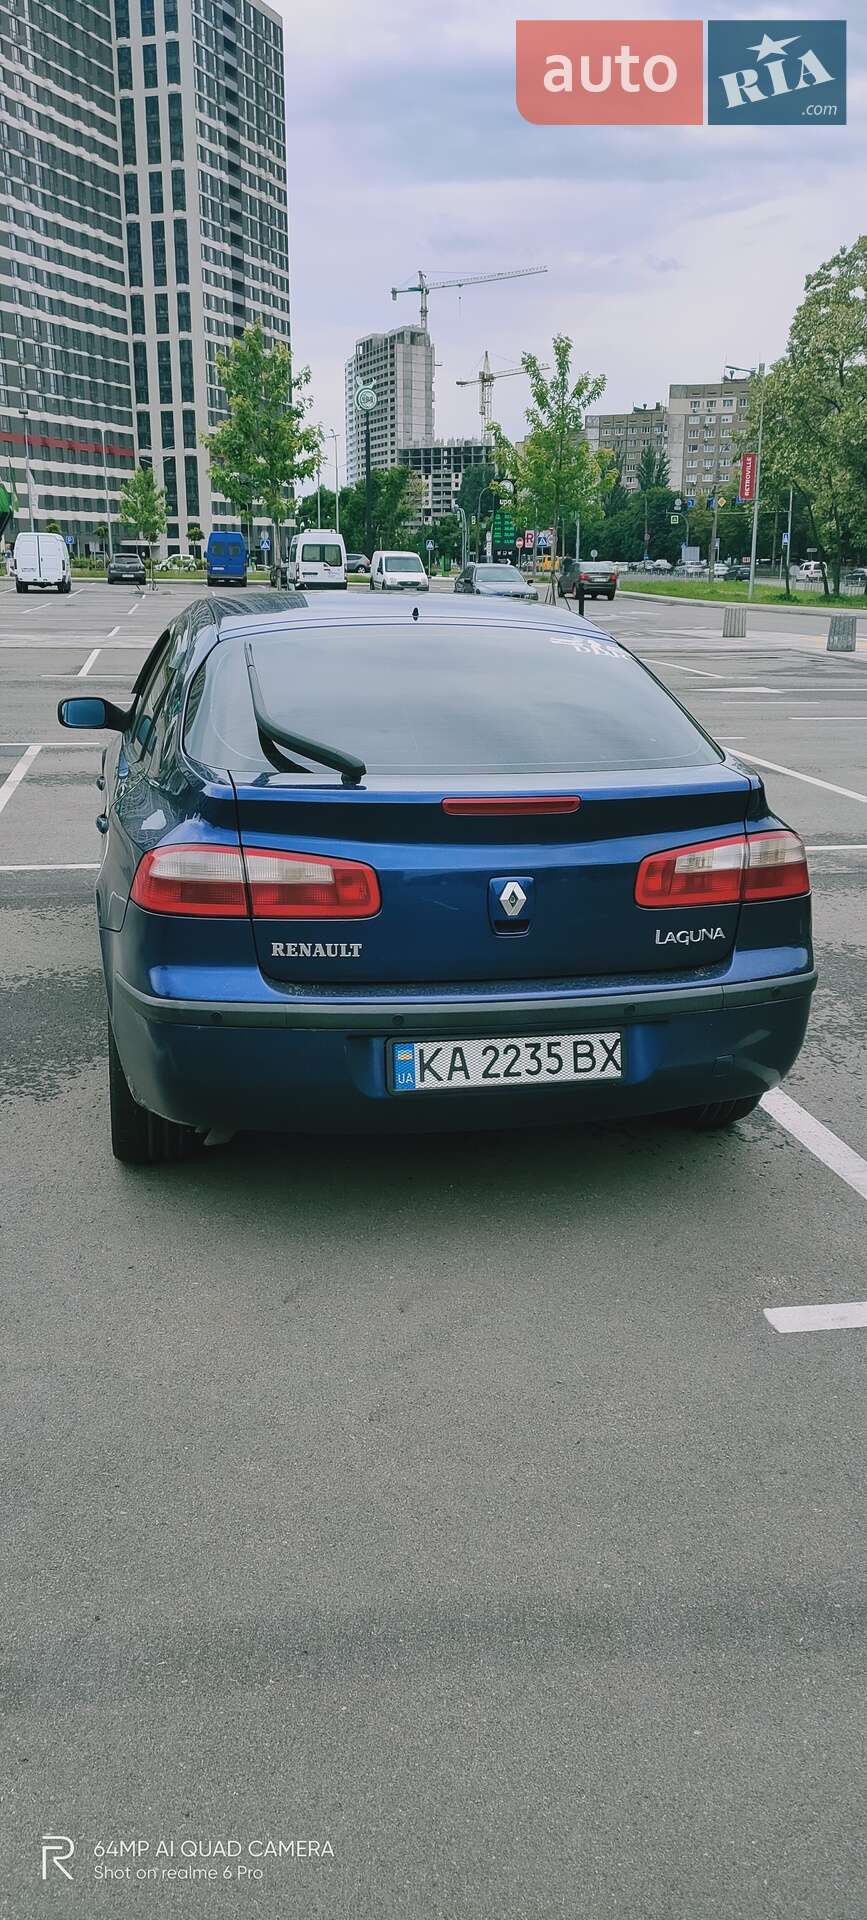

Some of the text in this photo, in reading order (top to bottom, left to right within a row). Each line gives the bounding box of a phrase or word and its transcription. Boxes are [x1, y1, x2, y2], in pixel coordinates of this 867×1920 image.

[655, 927, 726, 945] LAGUNA
[271, 942, 362, 957] RENAULT
[418, 1038, 622, 1083] KA 2235 BX
[398, 1073, 414, 1085] UA
